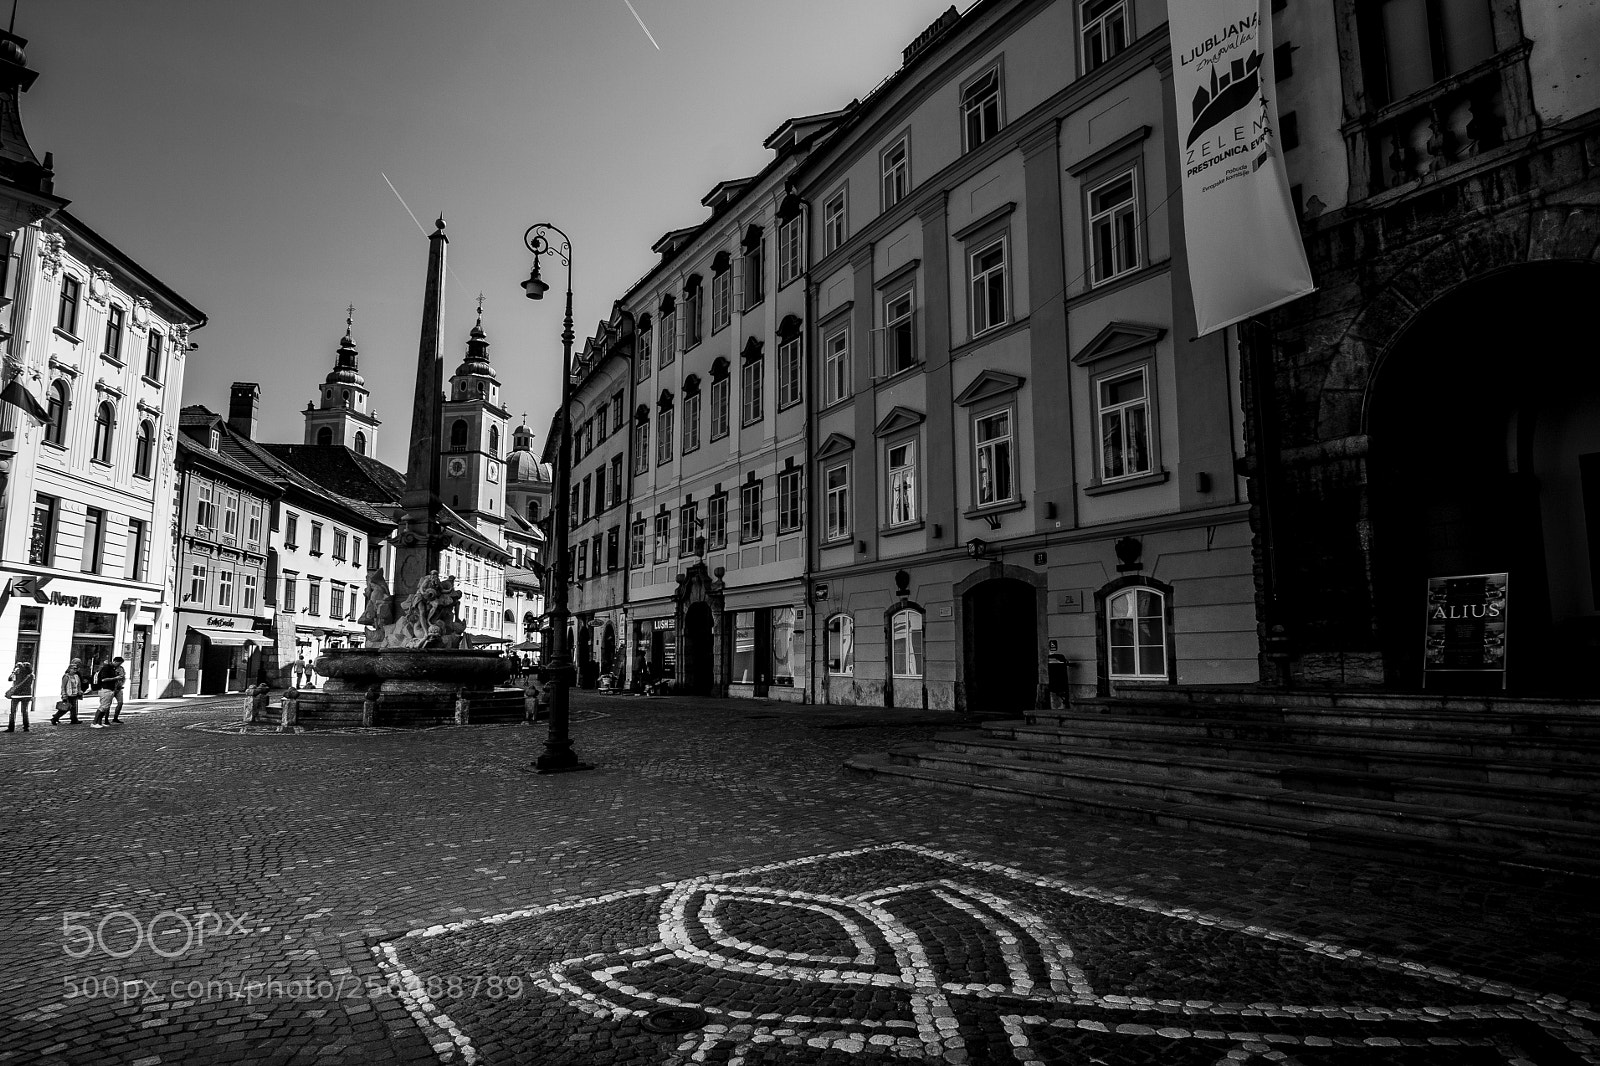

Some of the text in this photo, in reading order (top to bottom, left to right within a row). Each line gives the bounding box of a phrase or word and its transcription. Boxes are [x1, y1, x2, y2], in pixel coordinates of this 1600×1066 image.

[1181, 12, 1259, 66] LJUBLJANA
[1186, 110, 1270, 165] ZELENA
[1187, 127, 1274, 178] PRESTOLNICA EVRPE
[1225, 164, 1248, 175] Pobuda
[1202, 178, 1225, 192] Evropske
[1432, 603, 1500, 619] ALIUS
[654, 619, 669, 630] LUSH
